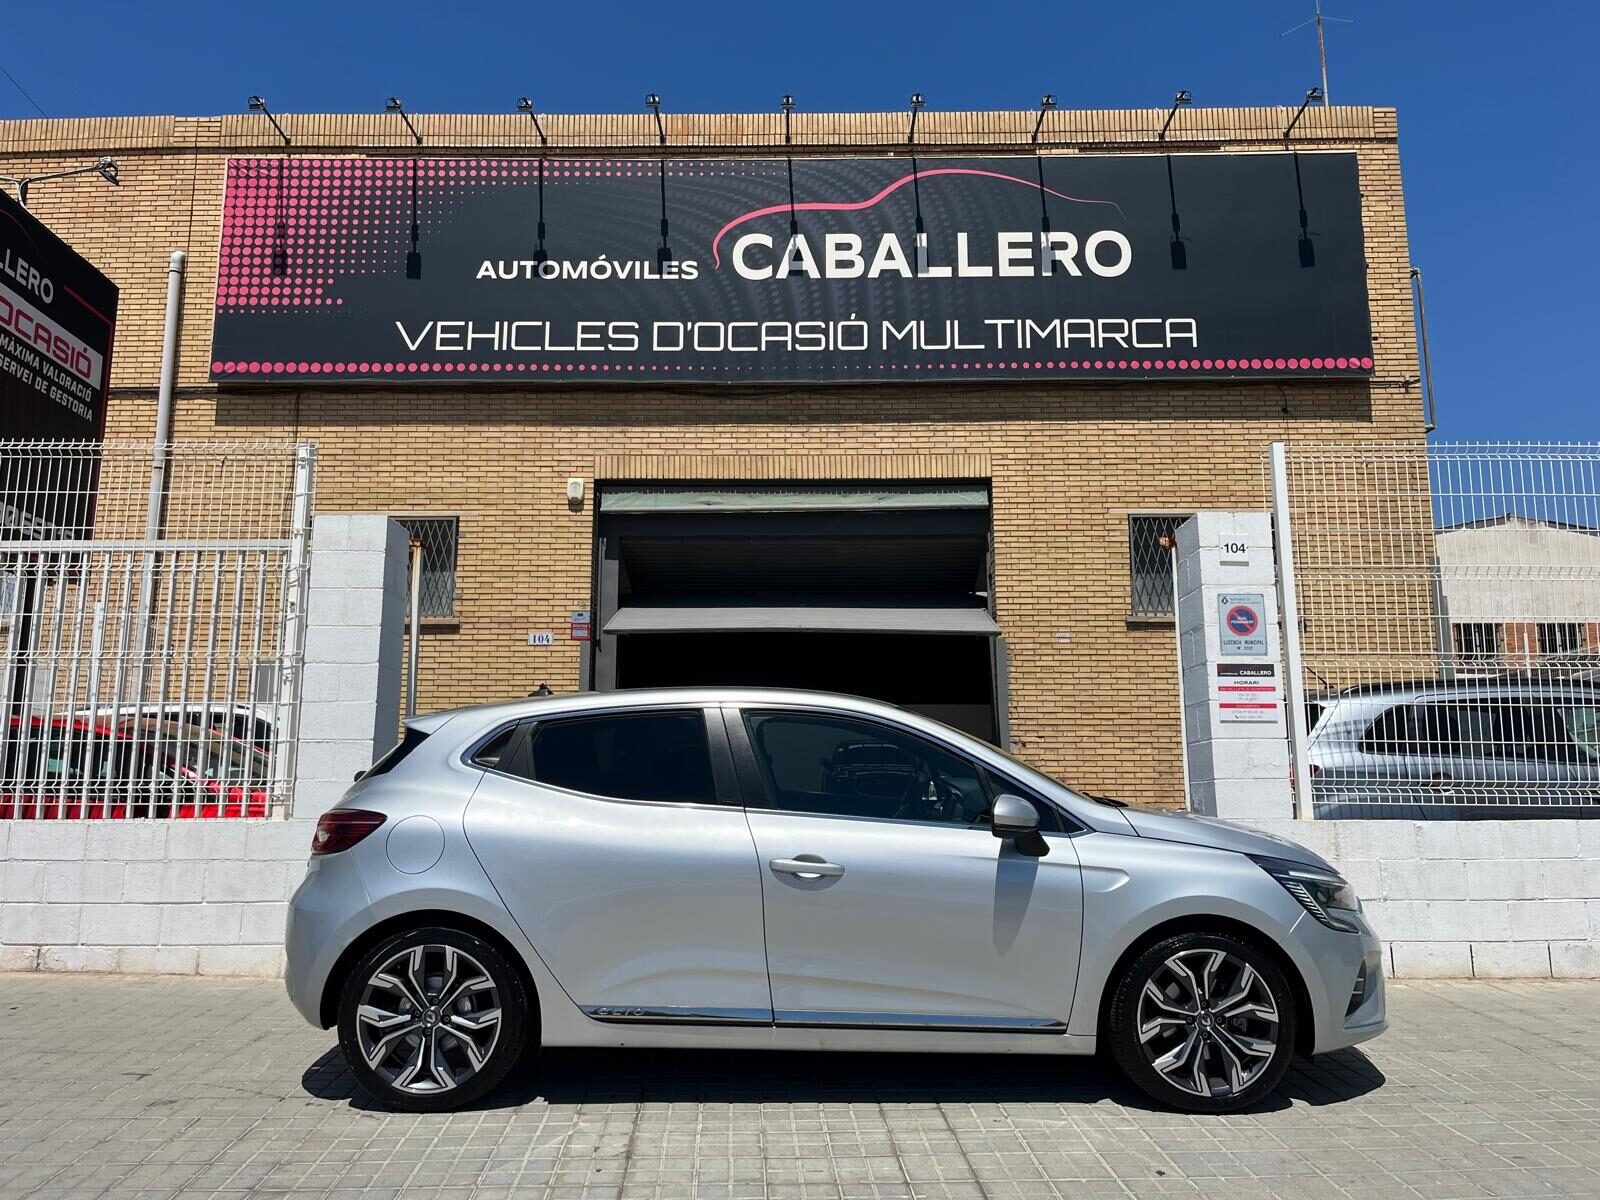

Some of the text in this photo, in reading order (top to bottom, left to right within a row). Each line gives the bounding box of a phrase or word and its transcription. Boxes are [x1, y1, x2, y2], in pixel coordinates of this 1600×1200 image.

[476, 230, 1132, 280] AUTOMÓVILES CABALLERO
[395, 313, 1198, 352] VEHICLES D'OCASIÓ MULTIMARCA
[35, 376, 48, 394] DE
[50, 386, 93, 422] GESTORIA
[43, 360, 92, 402] VALORACIÓ
[1223, 543, 1247, 554] 104
[533, 634, 550, 644] 104
